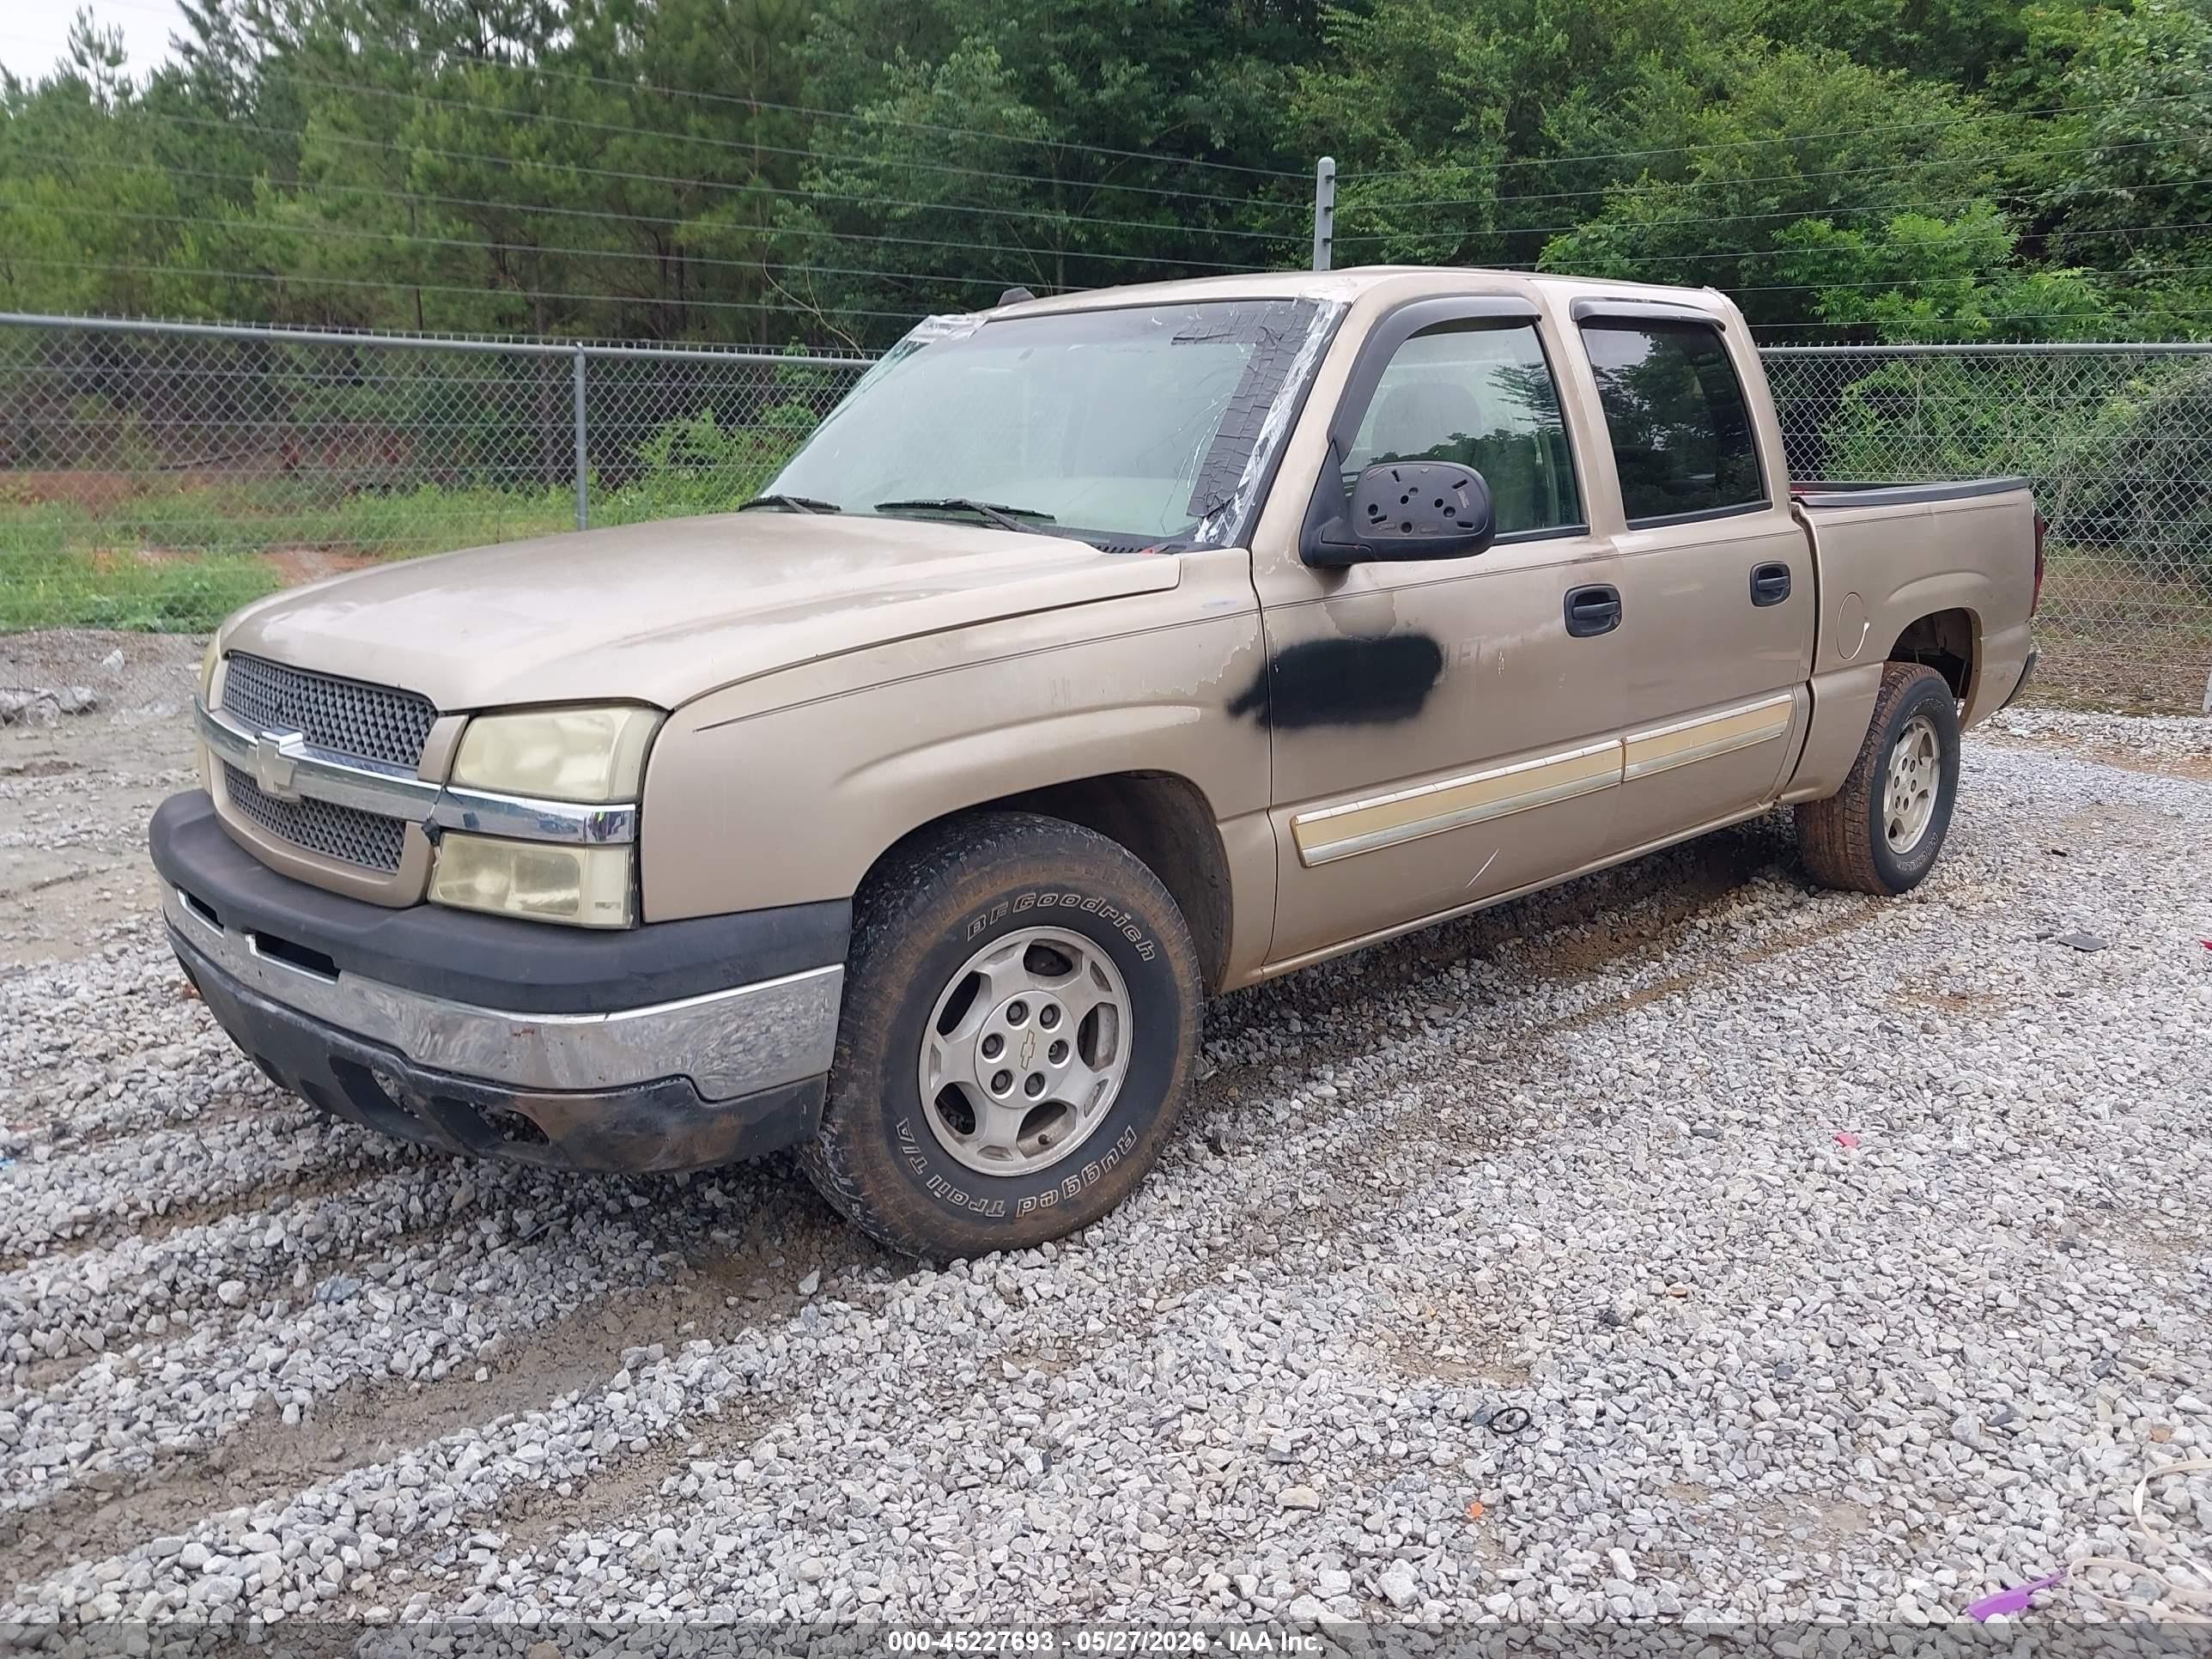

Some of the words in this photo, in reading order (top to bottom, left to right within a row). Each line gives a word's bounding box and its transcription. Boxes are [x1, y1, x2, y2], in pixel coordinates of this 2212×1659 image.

[896, 1117, 928, 1176] T/A
[1016, 1125, 1138, 1218] Rugged
[926, 1174, 1006, 1218] Trail
